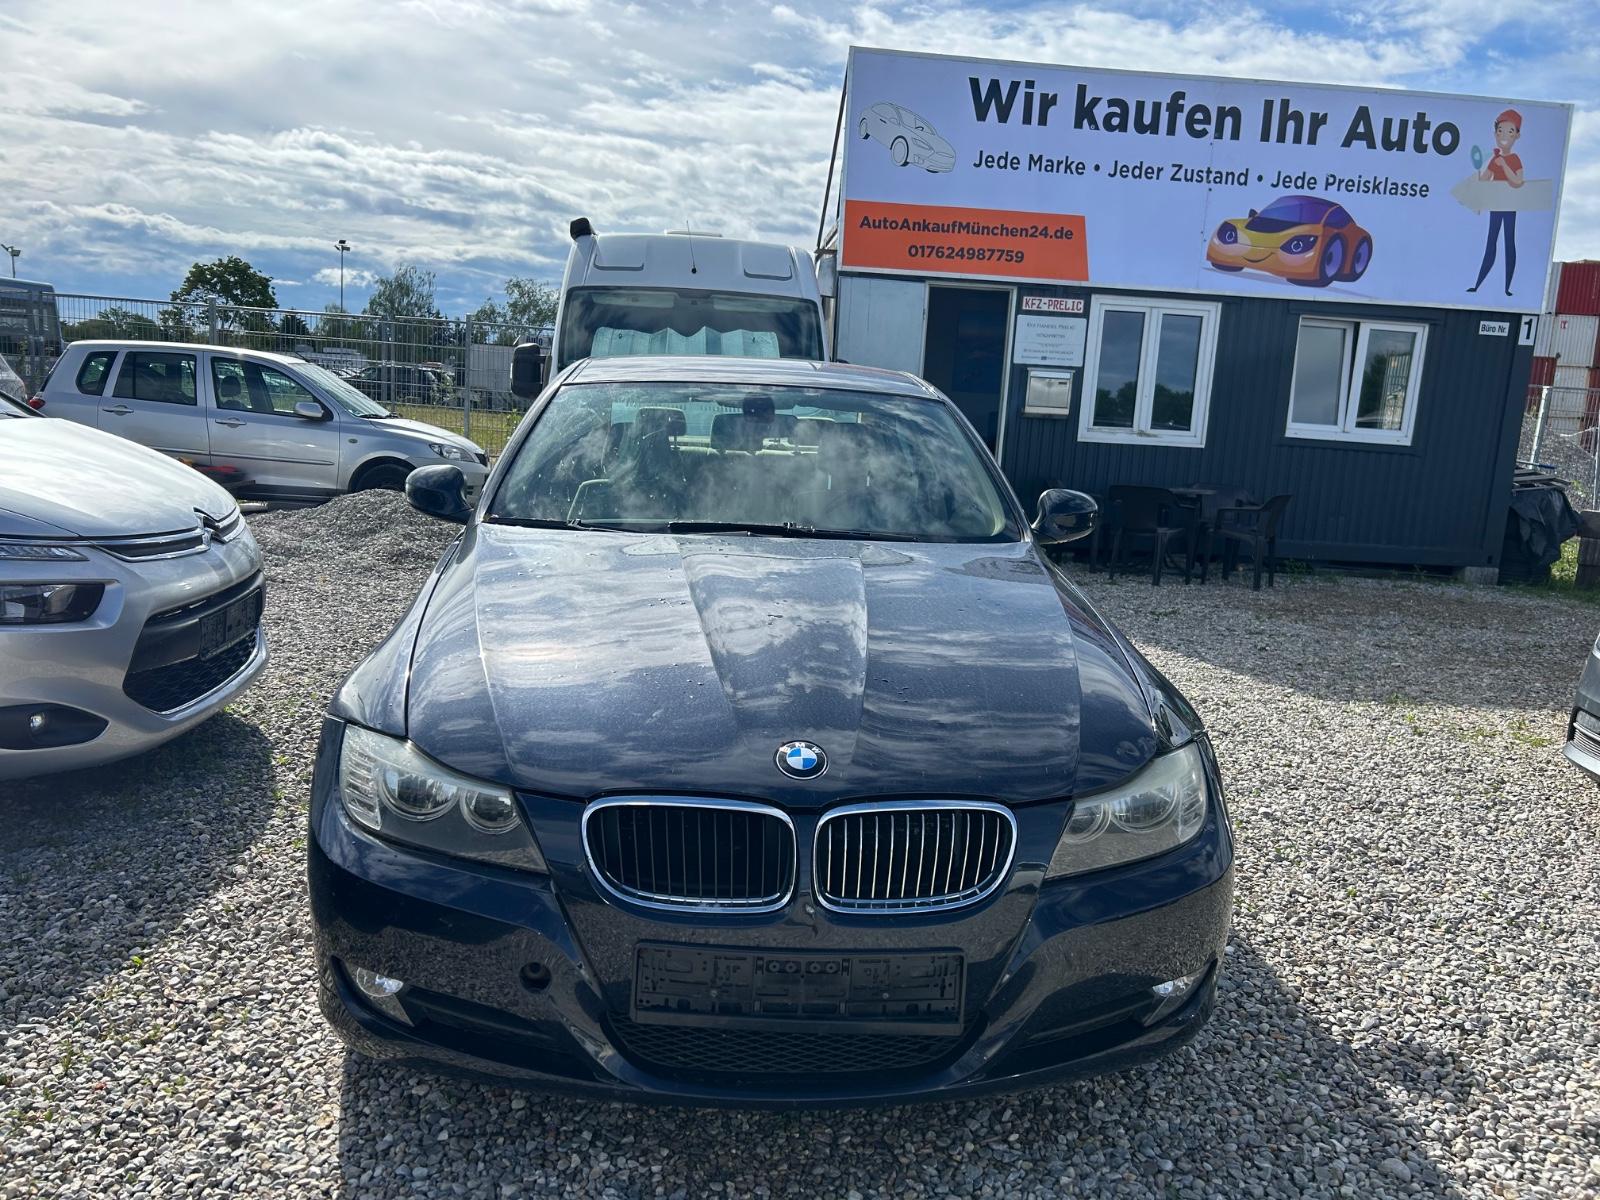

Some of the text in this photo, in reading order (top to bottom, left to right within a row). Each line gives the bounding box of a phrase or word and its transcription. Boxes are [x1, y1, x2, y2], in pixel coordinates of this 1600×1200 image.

[968, 76, 1461, 156] Wir kaufen Ihr Auto
[972, 149, 1430, 198] Jede Marke Jeder Zustand Jede Preisklasse
[858, 215, 1074, 240] AutoAnkaufMünchen24.de
[907, 244, 1025, 264] 017624987759
[1024, 297, 1082, 312] KFZ-PRELIC
[1480, 323, 1497, 334] Büro
[1523, 318, 1534, 341] 1
[779, 742, 822, 753] BMW
